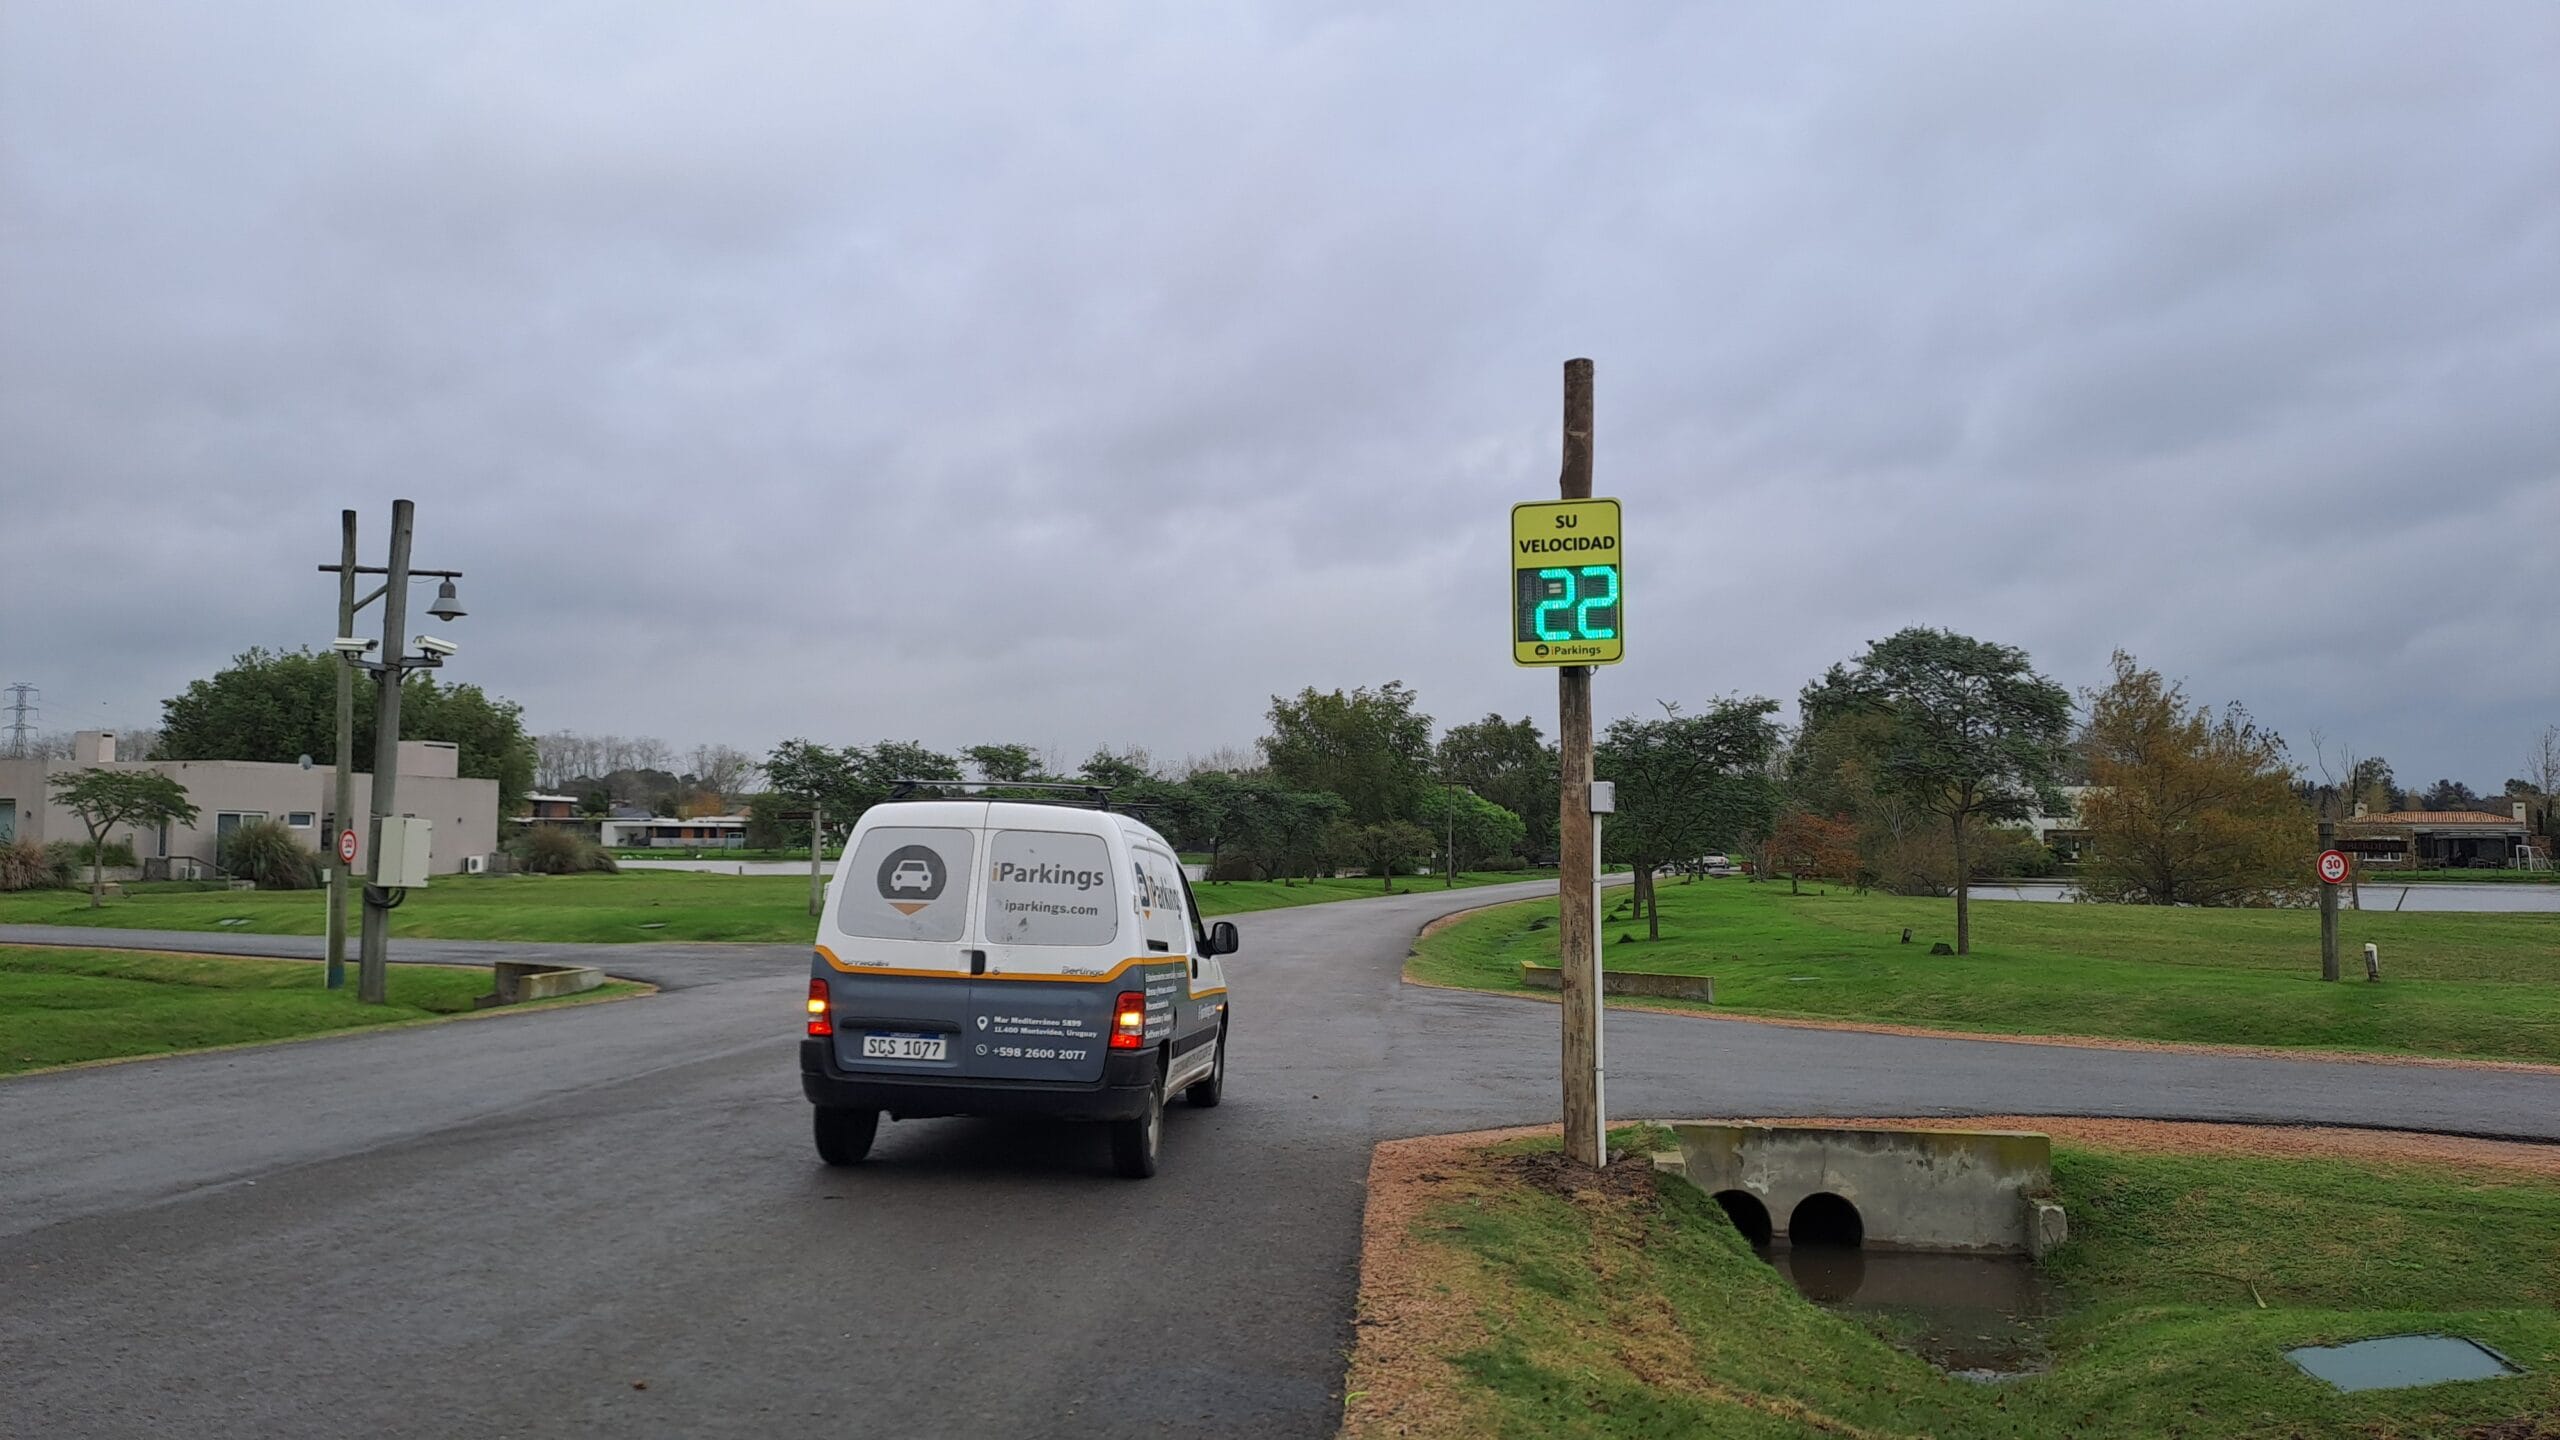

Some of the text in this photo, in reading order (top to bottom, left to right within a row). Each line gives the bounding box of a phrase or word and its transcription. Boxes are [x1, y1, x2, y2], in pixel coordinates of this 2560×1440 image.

[1555, 514, 1578, 529] SU
[1519, 535, 1615, 553] VELOCIDAD
[1535, 566, 1619, 641] 22
[1551, 645, 1602, 657] iParkings
[2325, 859, 2341, 870] 30
[991, 861, 1105, 891] iParkings
[1004, 899, 1099, 916] iparkings.com
[993, 1015, 1009, 1024] Mar
[1066, 1030, 1098, 1039] Uruguay
[868, 1038, 941, 1058] SCS 1077
[992, 1046, 1087, 1061] +598 2600 2077
